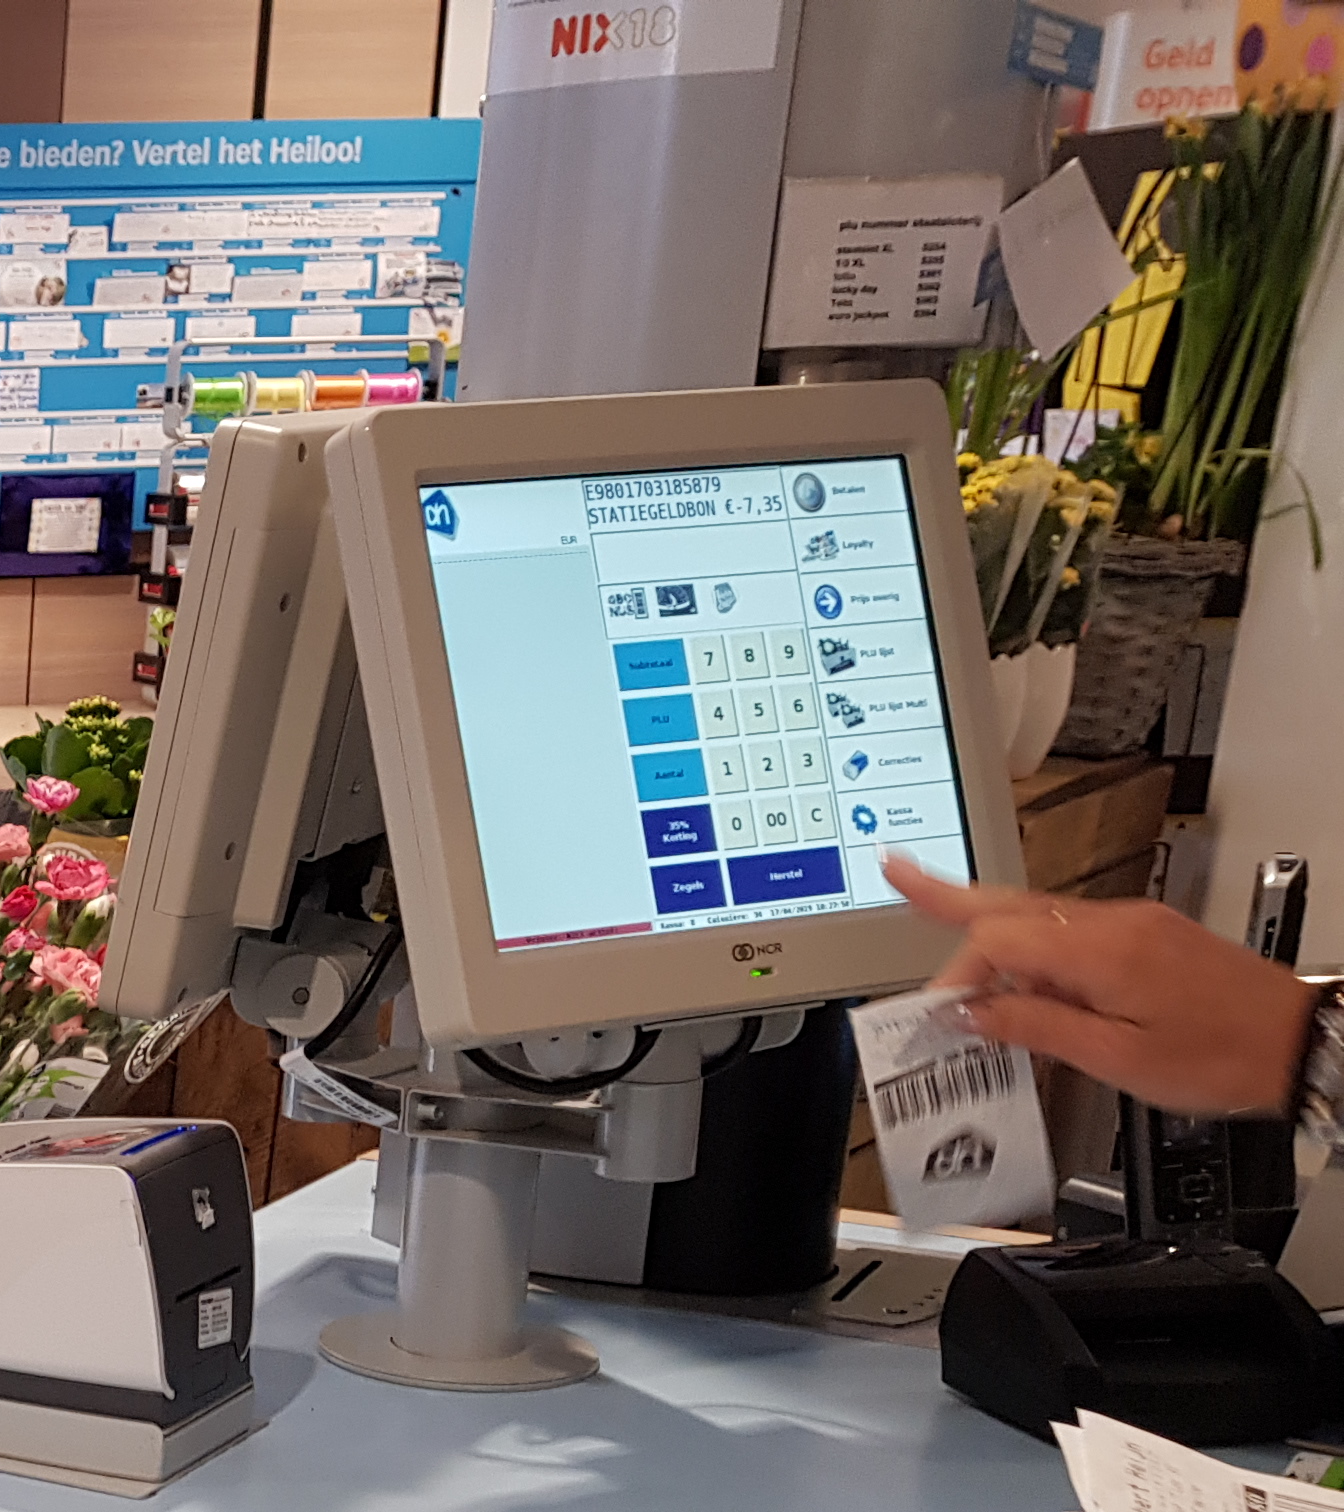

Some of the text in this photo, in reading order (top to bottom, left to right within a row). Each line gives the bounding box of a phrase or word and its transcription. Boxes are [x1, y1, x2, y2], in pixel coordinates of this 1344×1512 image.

[551, 6, 675, 58] NIX18
[19, 139, 124, 168] bieden?
[132, 137, 211, 166] Vertel
[218, 136, 262, 165] het
[269, 135, 362, 163] Heiloo!
[585, 476, 721, 501] E9801703185879
[587, 499, 716, 525] STATIEGELDBON
[842, 538, 875, 551] Loyalty
[703, 652, 714, 666] 7
[745, 649, 755, 663] 8
[784, 645, 794, 659] 9
[754, 703, 764, 717] 5
[793, 699, 804, 713] 6
[713, 707, 724, 721] 4
[763, 758, 774, 772] 2
[802, 754, 813, 768] 3
[723, 762, 733, 776] 1
[766, 811, 787, 827] 00
[811, 808, 822, 822] C
[732, 817, 742, 831] 0
[663, 829, 698, 843] Korting
[769, 868, 803, 882] Herstel
[672, 880, 705, 895] Zegels
[756, 943, 784, 957] NCR
